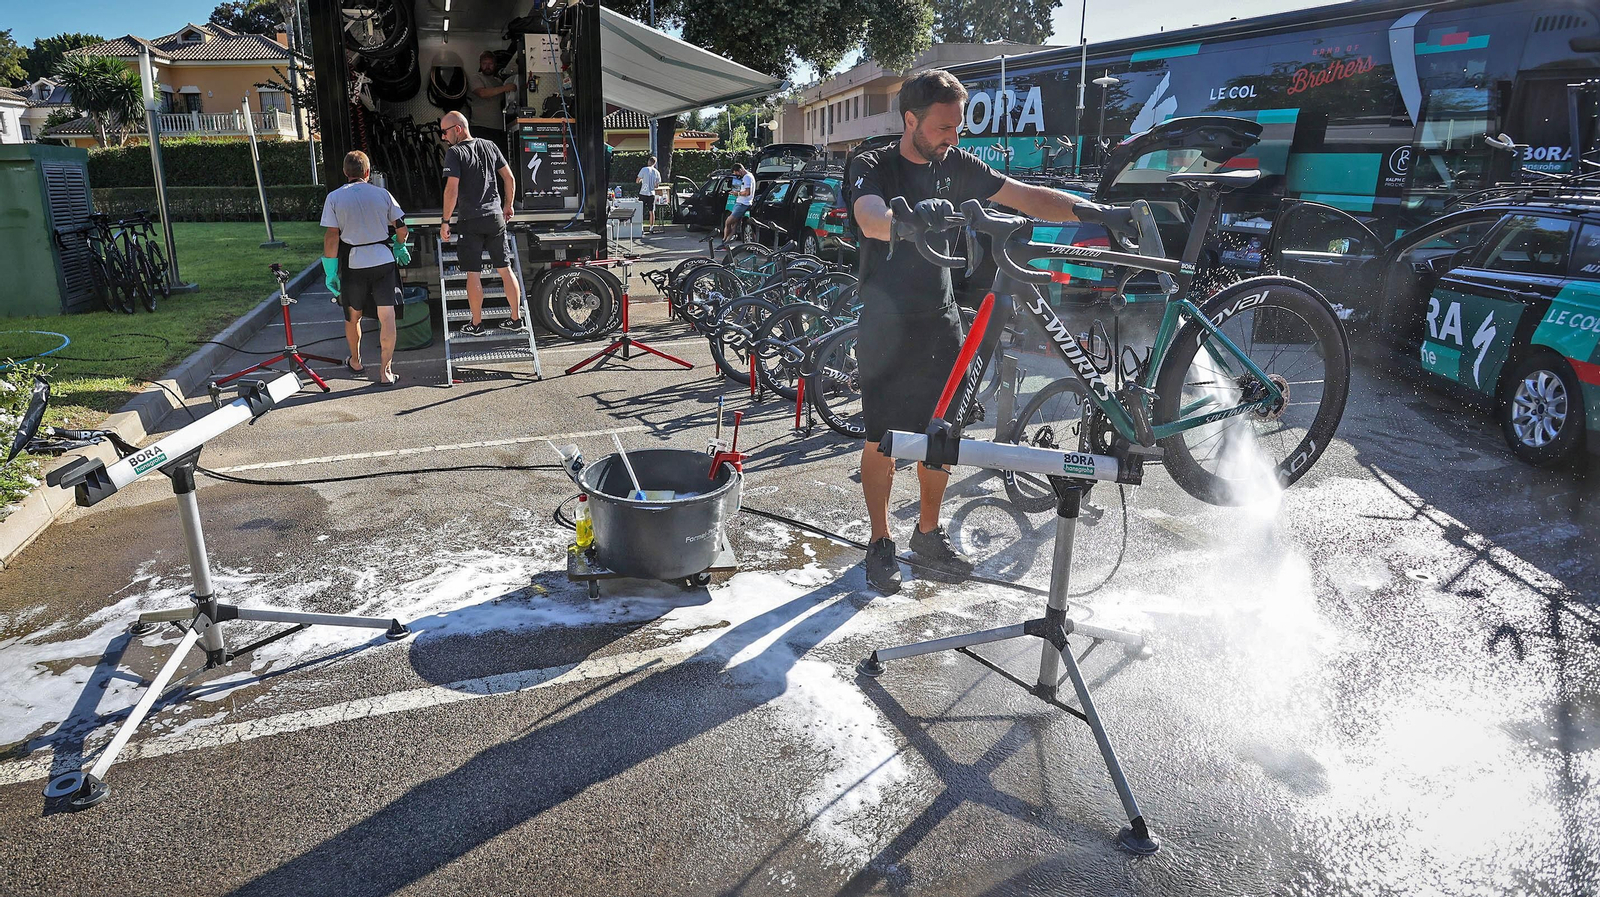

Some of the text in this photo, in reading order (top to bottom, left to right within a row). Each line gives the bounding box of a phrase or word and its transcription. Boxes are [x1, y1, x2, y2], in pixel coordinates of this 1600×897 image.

[1287, 55, 1377, 95] Brothers
[1209, 84, 1258, 101] LE COL
[957, 86, 1045, 135] ORA
[1050, 246, 1102, 258] SPECIALIZED
[1545, 309, 1571, 325] LE
[1025, 297, 1110, 401] S-WORKS
[956, 355, 983, 427] SPECIALIZED
[1205, 402, 1263, 424] SPECIALIZED
[128, 445, 163, 468] BORA
[134, 454, 167, 474] hansgrohe
[1064, 453, 1095, 466] BORA
